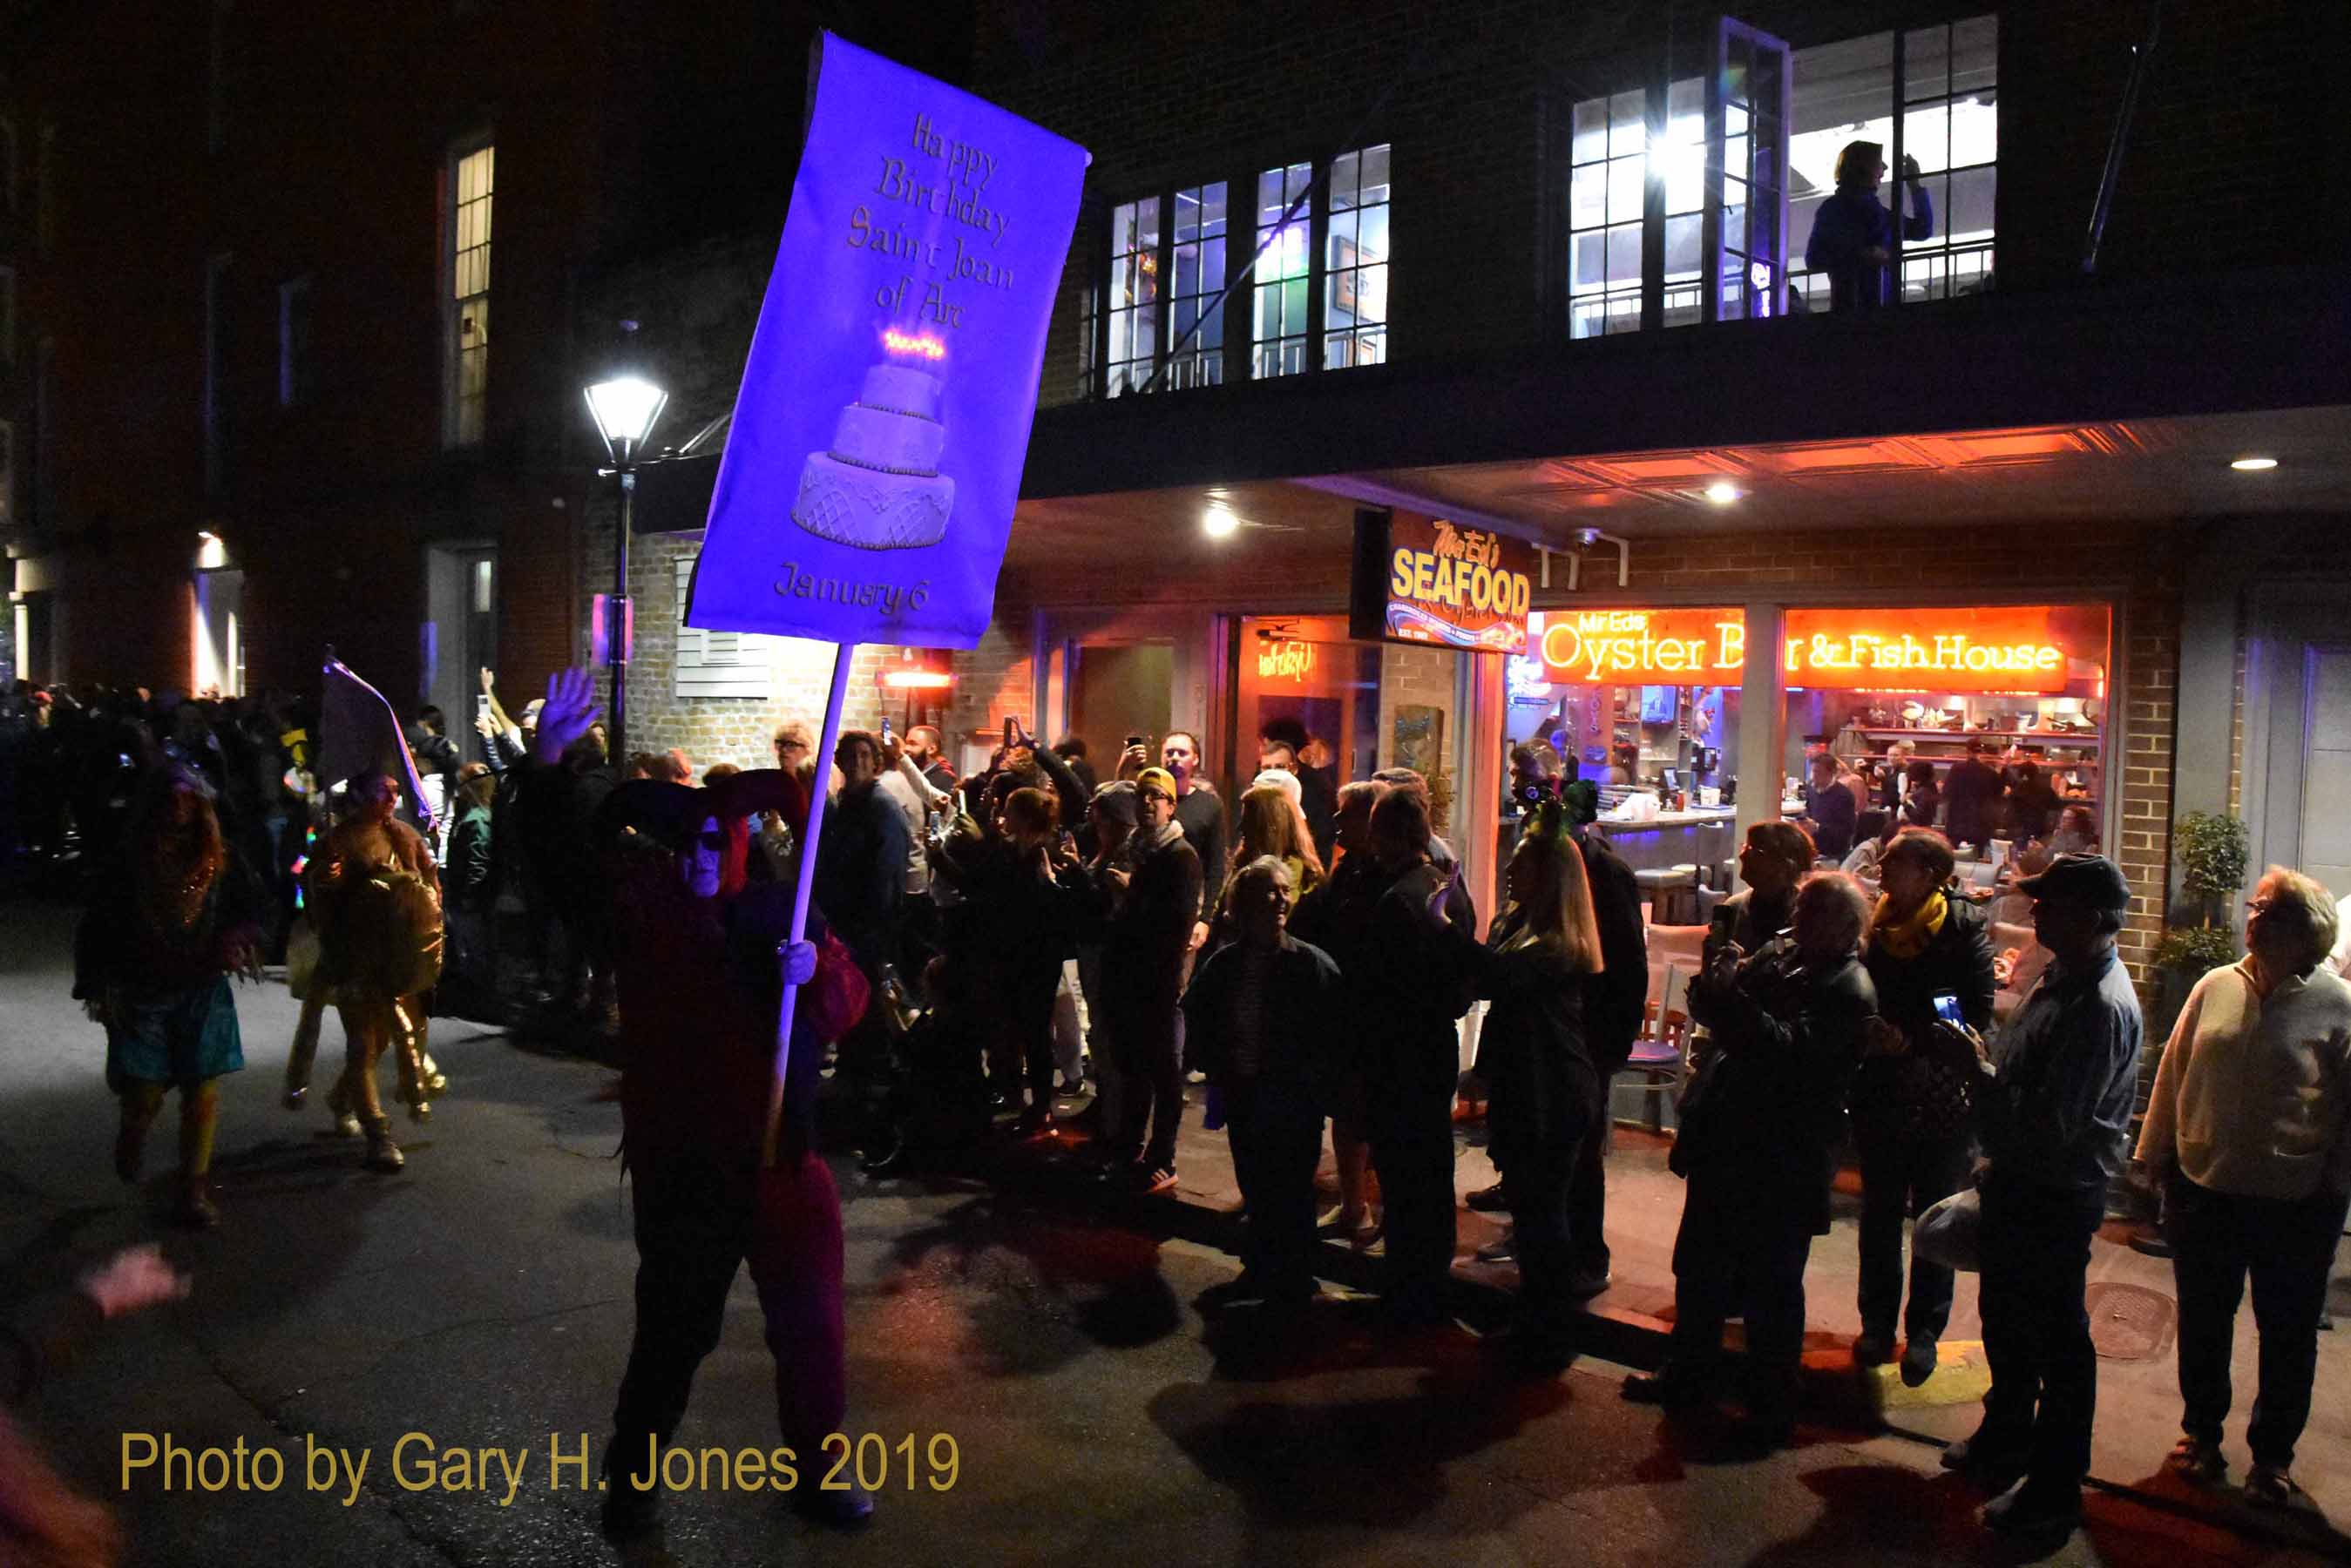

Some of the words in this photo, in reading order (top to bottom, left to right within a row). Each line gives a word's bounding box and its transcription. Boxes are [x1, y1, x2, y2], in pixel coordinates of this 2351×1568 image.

[912, 112, 999, 192] Happy
[875, 154, 1010, 248] Birthday
[847, 204, 942, 269] Saint
[947, 237, 1013, 290] Joan
[876, 276, 912, 314] of
[919, 280, 965, 328] Arc
[775, 562, 903, 614] January
[908, 578, 931, 610] 6
[1392, 548, 1530, 615] SEAFOOD
[1541, 623, 1706, 680] Oyster
[1712, 622, 1803, 671] Br
[1809, 633, 1844, 667] &
[1848, 634, 1930, 668] Fish
[1932, 634, 2063, 670] House
